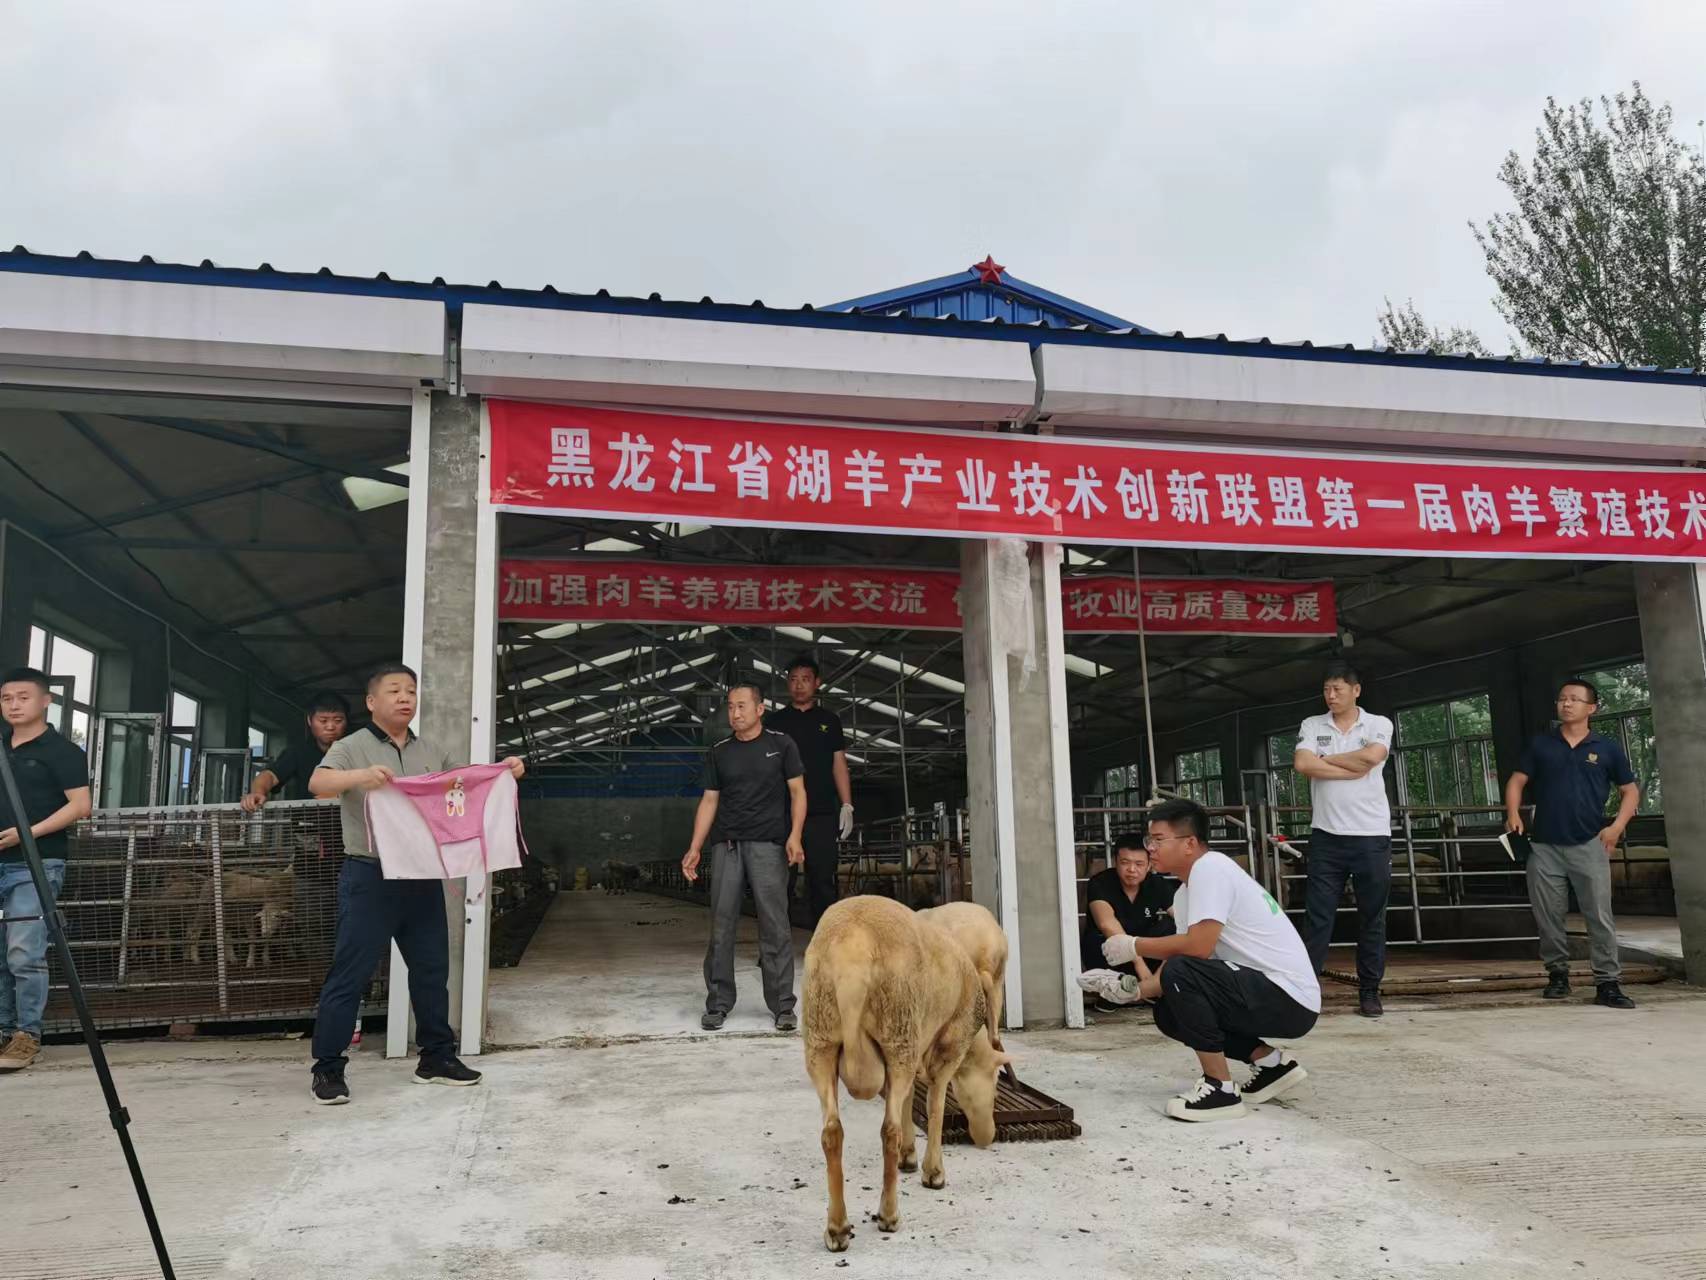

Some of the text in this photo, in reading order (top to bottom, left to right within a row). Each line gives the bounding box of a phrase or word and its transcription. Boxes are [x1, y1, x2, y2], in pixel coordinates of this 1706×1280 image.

[547, 428, 1706, 540] 黑龙江省湖羊产业技术创新联盟第一届肉羊繁殖技术
[503, 573, 927, 614] 加强肉羊养殖技术交流
